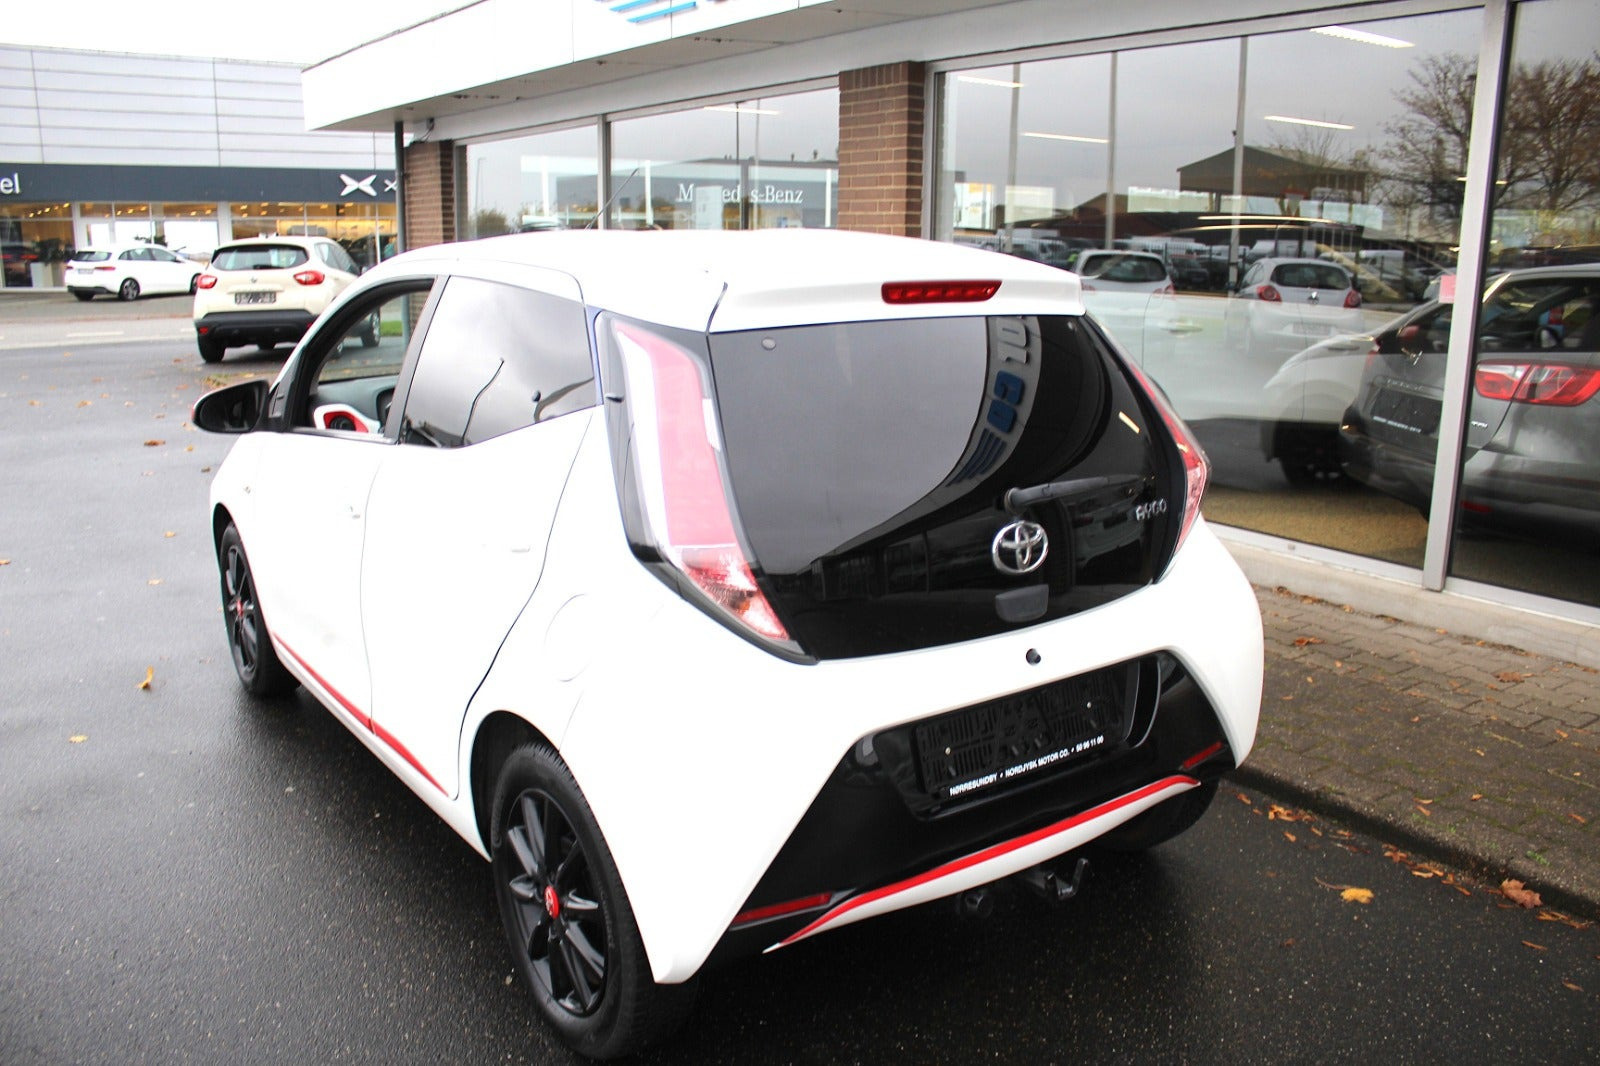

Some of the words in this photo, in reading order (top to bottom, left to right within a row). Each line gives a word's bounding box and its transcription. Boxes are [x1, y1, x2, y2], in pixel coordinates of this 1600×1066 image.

[0, 172, 20, 195] el
[676, 183, 804, 204] Meds-Benz
[1135, 498, 1168, 521] AYGO
[1005, 758, 1038, 778] NORDJYSK
[1037, 751, 1059, 767] MOTOR
